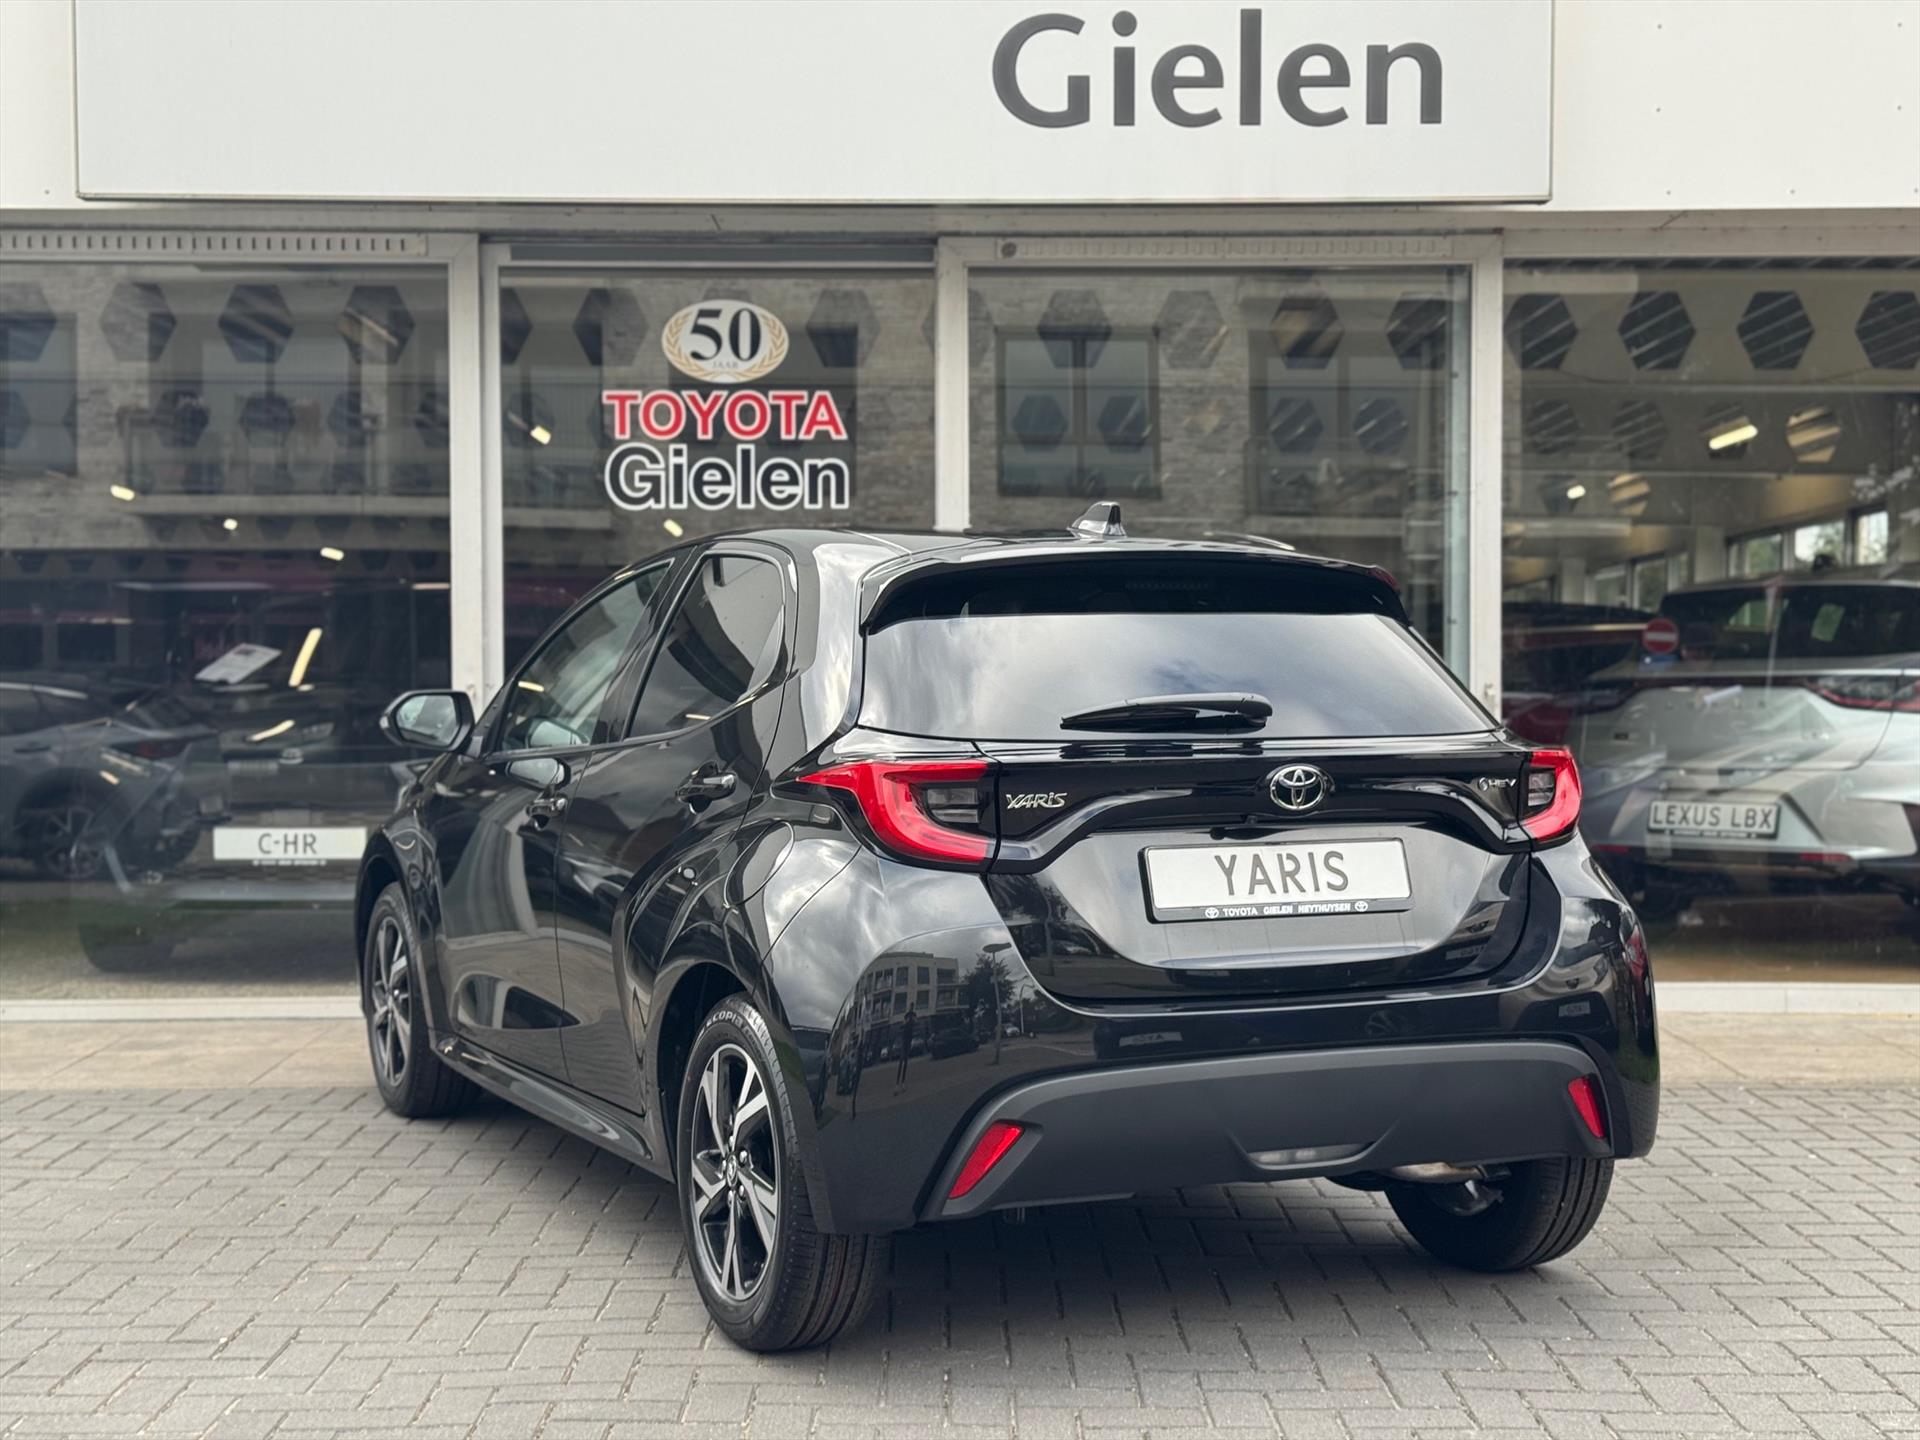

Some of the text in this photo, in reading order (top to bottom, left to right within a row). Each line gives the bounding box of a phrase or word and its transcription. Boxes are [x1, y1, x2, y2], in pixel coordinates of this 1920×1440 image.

[992, 8, 1443, 128] Gielen
[690, 308, 761, 361] 50
[602, 390, 848, 440] TOYOTA
[604, 442, 850, 511] Gielen
[1005, 791, 1068, 810] YARIS
[1653, 804, 1774, 829] LEXUS LBX
[258, 833, 318, 855] C-HR
[1214, 850, 1349, 896] YARIS
[1223, 906, 1258, 917] TOYOTA
[1263, 905, 1293, 915] GIELEN
